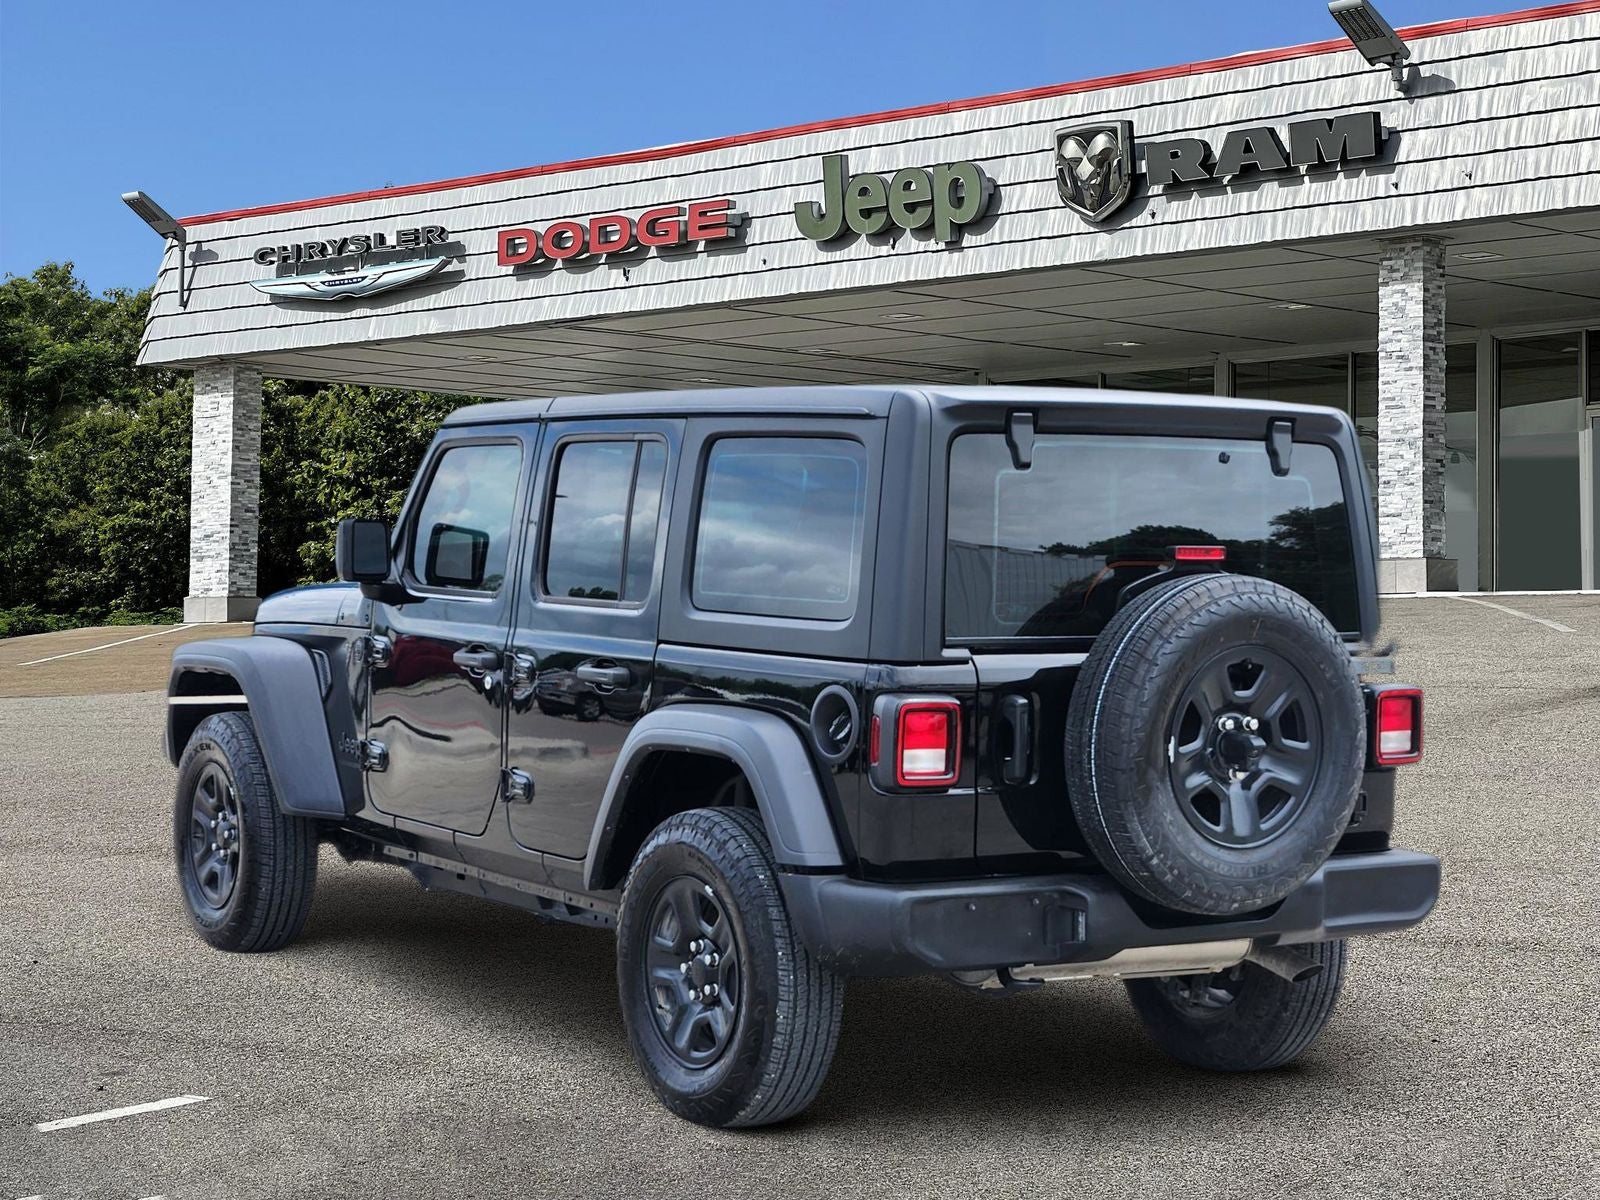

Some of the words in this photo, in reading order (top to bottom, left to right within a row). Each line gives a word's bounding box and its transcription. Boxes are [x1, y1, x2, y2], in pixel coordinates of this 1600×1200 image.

[1145, 112, 1381, 186] RAM
[498, 199, 734, 265] DODGE
[795, 155, 989, 242] Jeep
[253, 225, 448, 265] CHRYSLER
